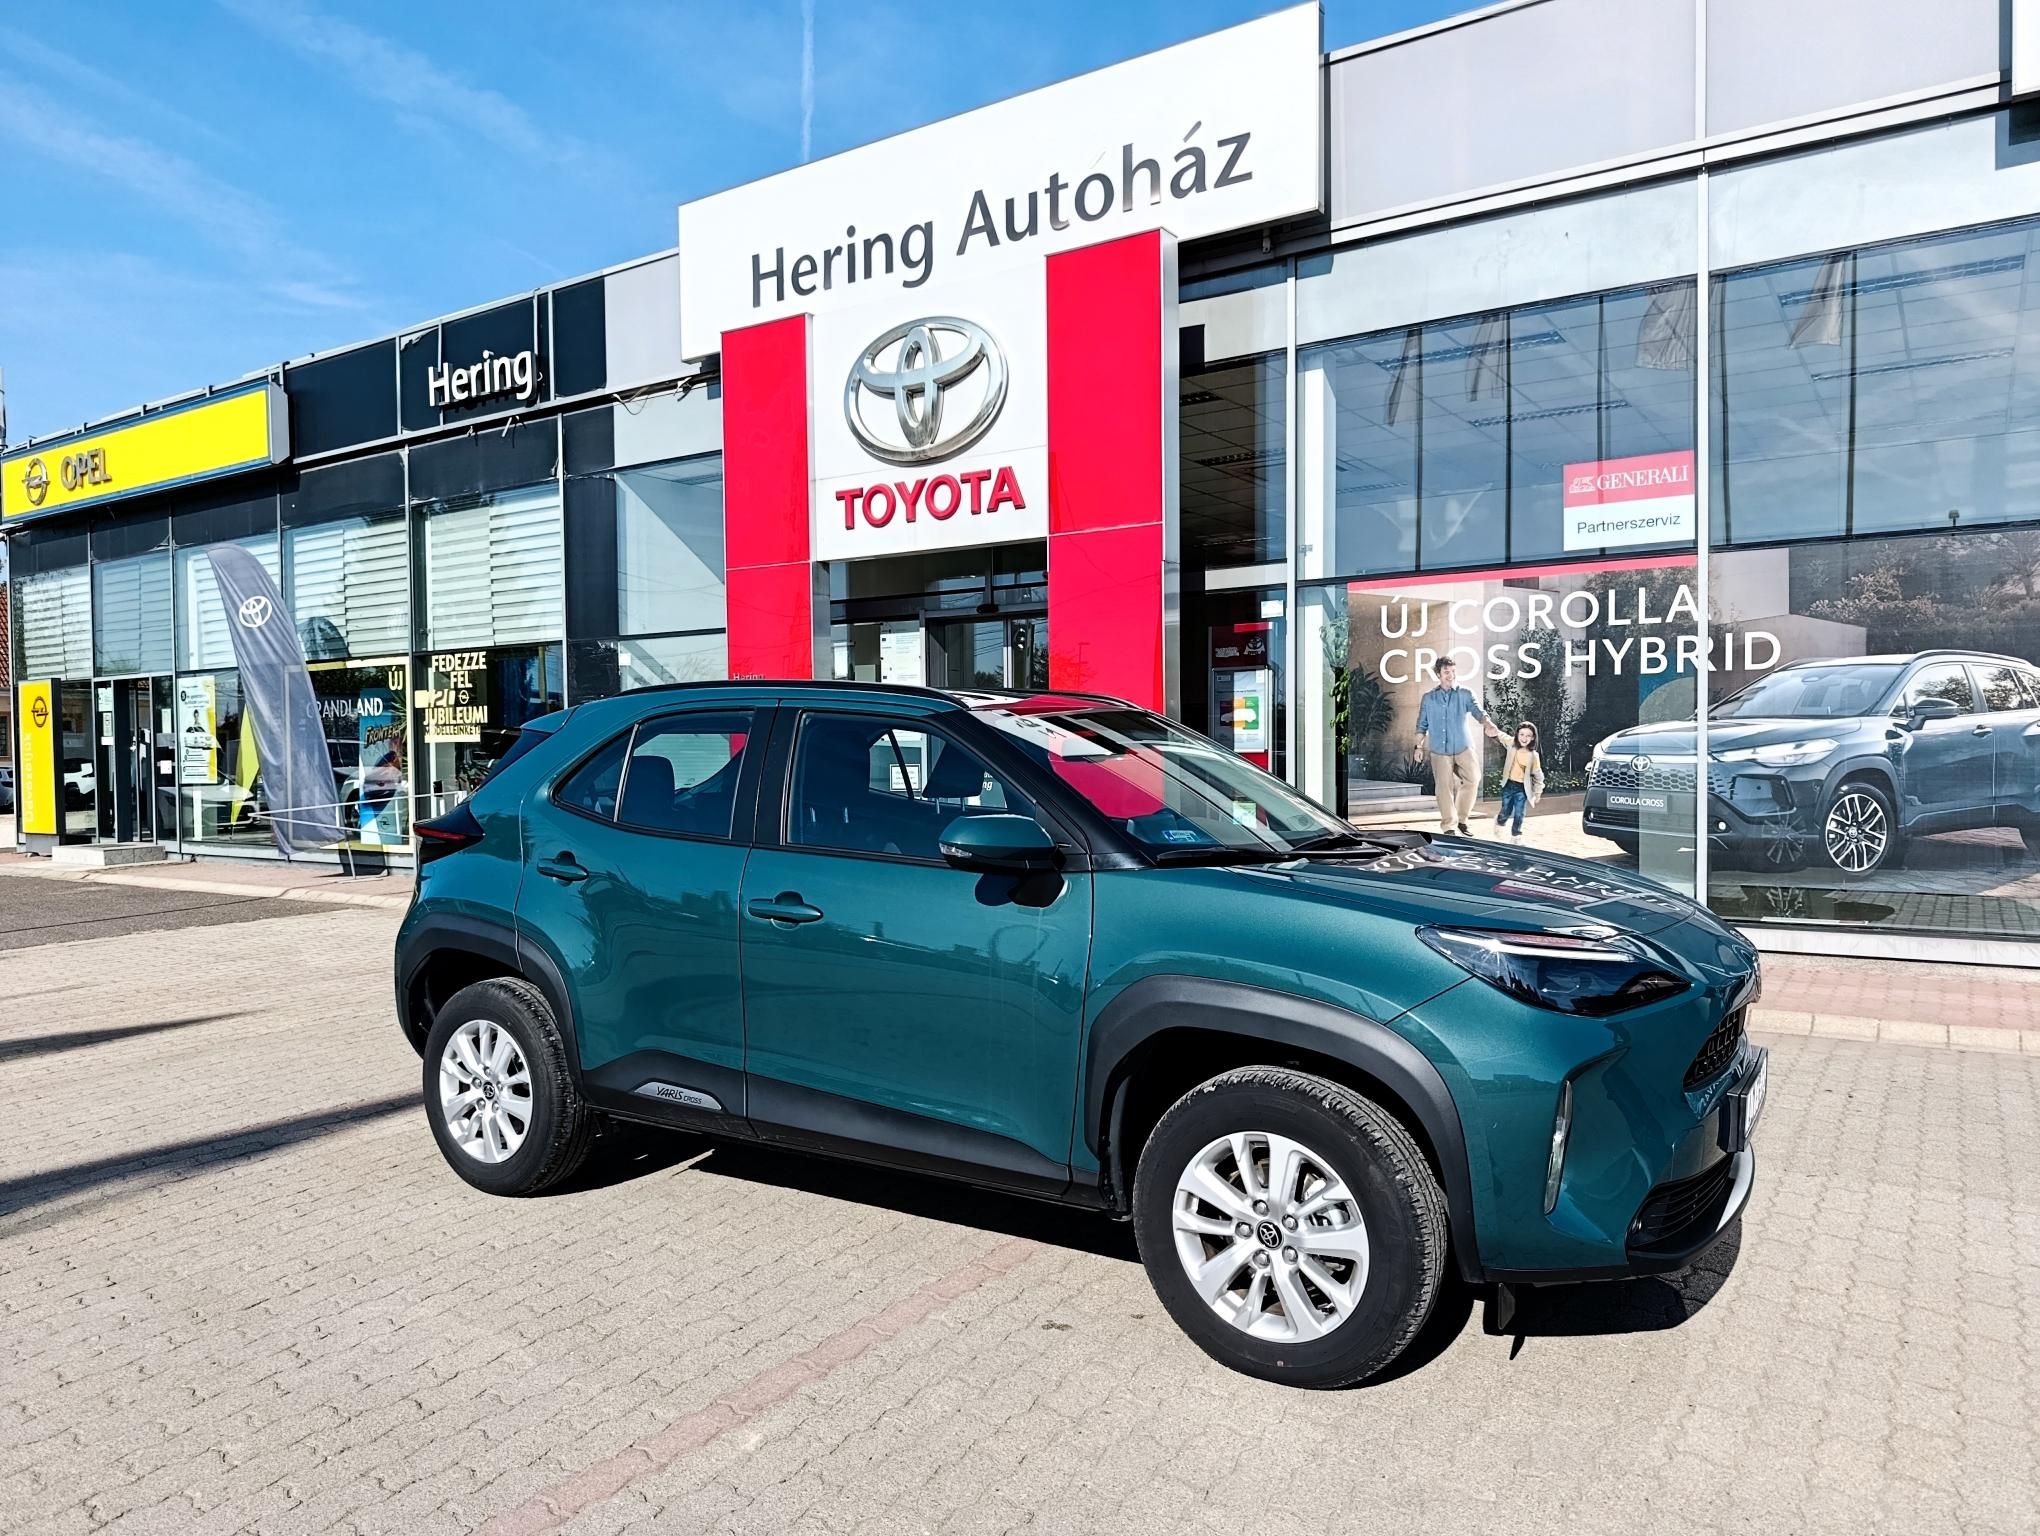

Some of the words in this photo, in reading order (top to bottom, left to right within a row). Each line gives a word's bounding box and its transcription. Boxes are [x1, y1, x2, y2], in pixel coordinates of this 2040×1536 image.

[752, 220, 933, 308] Hering
[956, 121, 1253, 256] Autoház
[428, 350, 533, 407] Hering
[60, 447, 112, 491] OPEL
[1597, 465, 1688, 490] GENERALI
[835, 466, 1026, 531] TOYOTA
[1577, 513, 1681, 535] Partnerszerviz
[1380, 595, 1428, 639] ÚJ
[1449, 584, 1712, 636] COROLLA
[431, 651, 487, 673] FEDEZZE
[1379, 642, 1543, 685] CROSS
[1564, 631, 1782, 678] HYBRID
[388, 666, 404, 691] ÚJ
[450, 670, 473, 689] FEL
[423, 705, 488, 726] JUBILEUMI
[1610, 796, 1640, 805] COROLLA
[1641, 798, 1665, 808] CROSS
[656, 1086, 684, 1100] YARIS
[683, 1095, 702, 1105] CROSS
